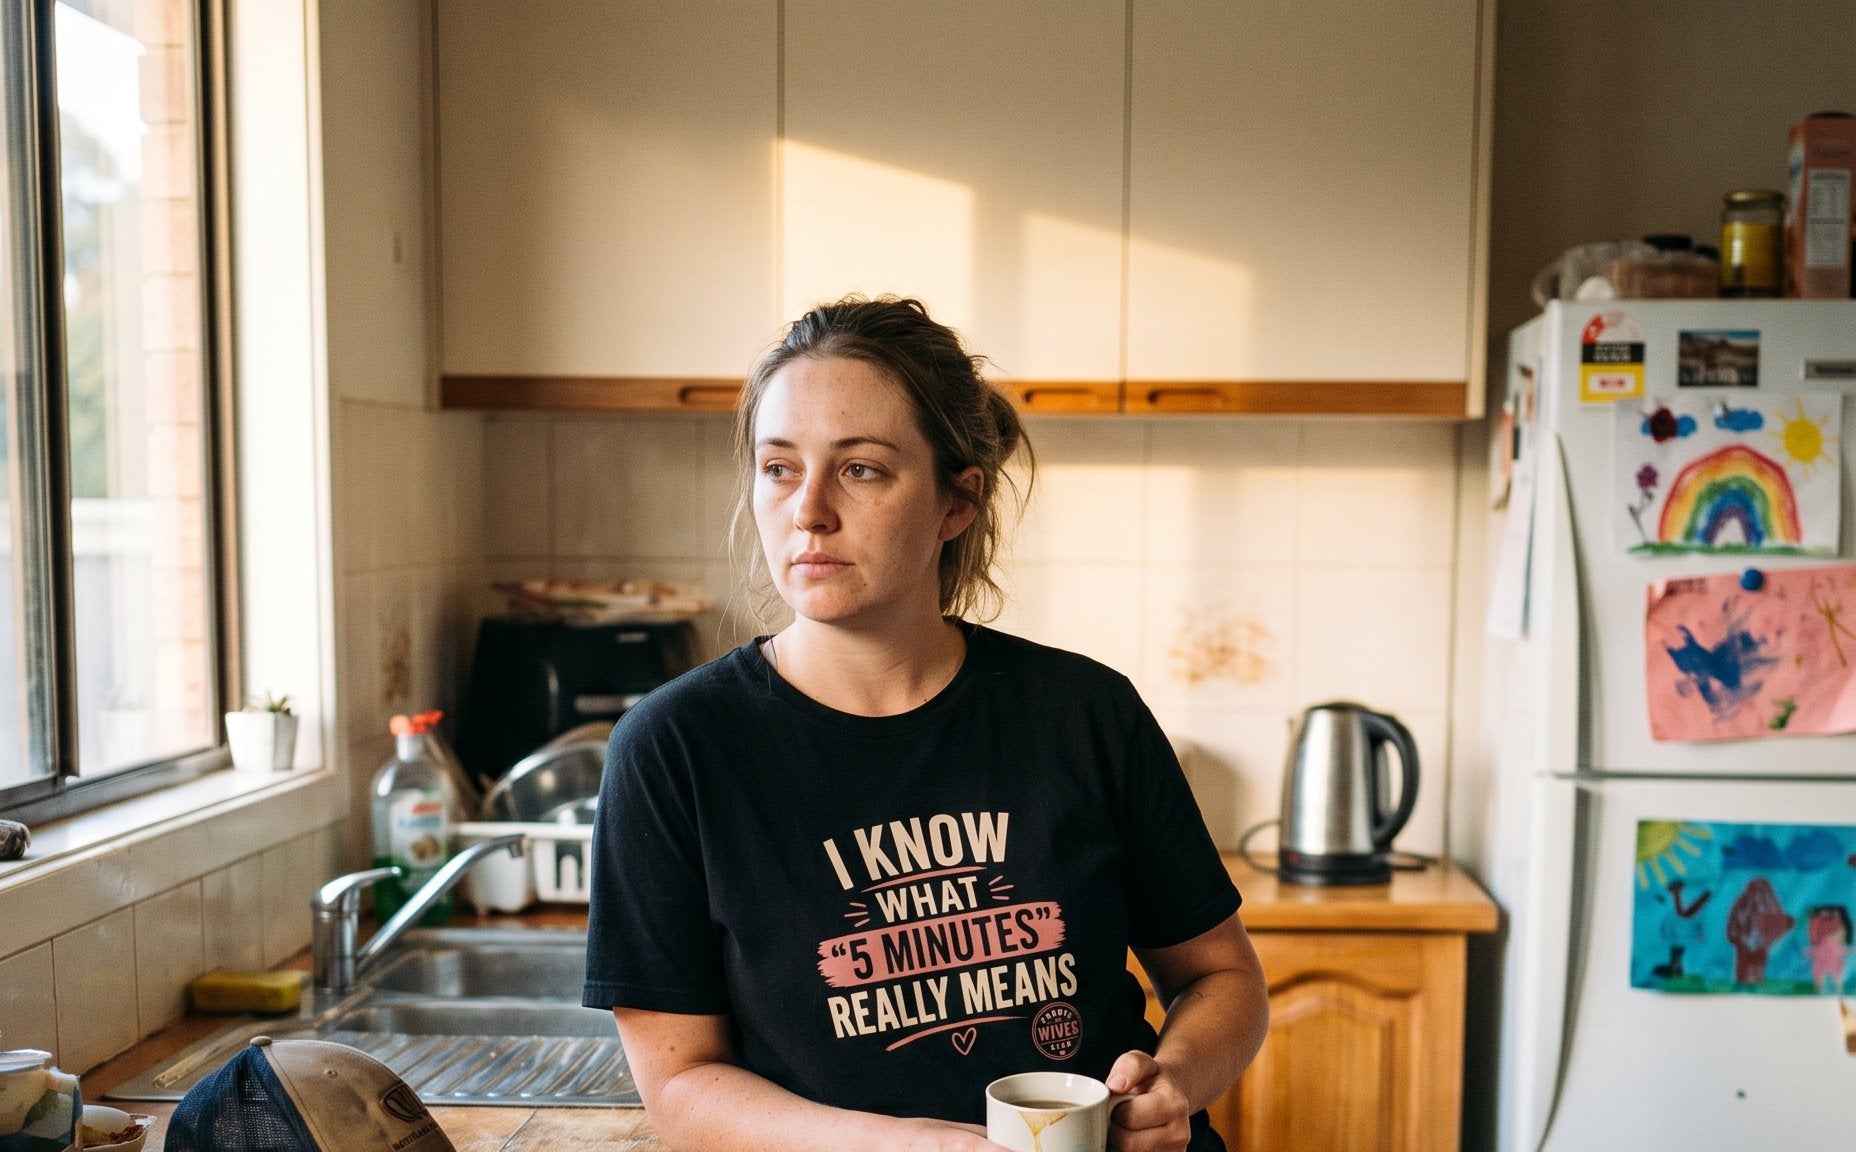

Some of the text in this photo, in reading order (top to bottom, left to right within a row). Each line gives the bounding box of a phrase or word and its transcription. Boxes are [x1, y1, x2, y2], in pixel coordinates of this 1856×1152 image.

[822, 812, 1010, 890] I KNOW
[875, 875, 979, 923] WHAT
[831, 906, 1050, 980] “5 MINUTES”
[827, 952, 1078, 1038] REALLY MEANS
[1037, 1020, 1080, 1042] WIVES
